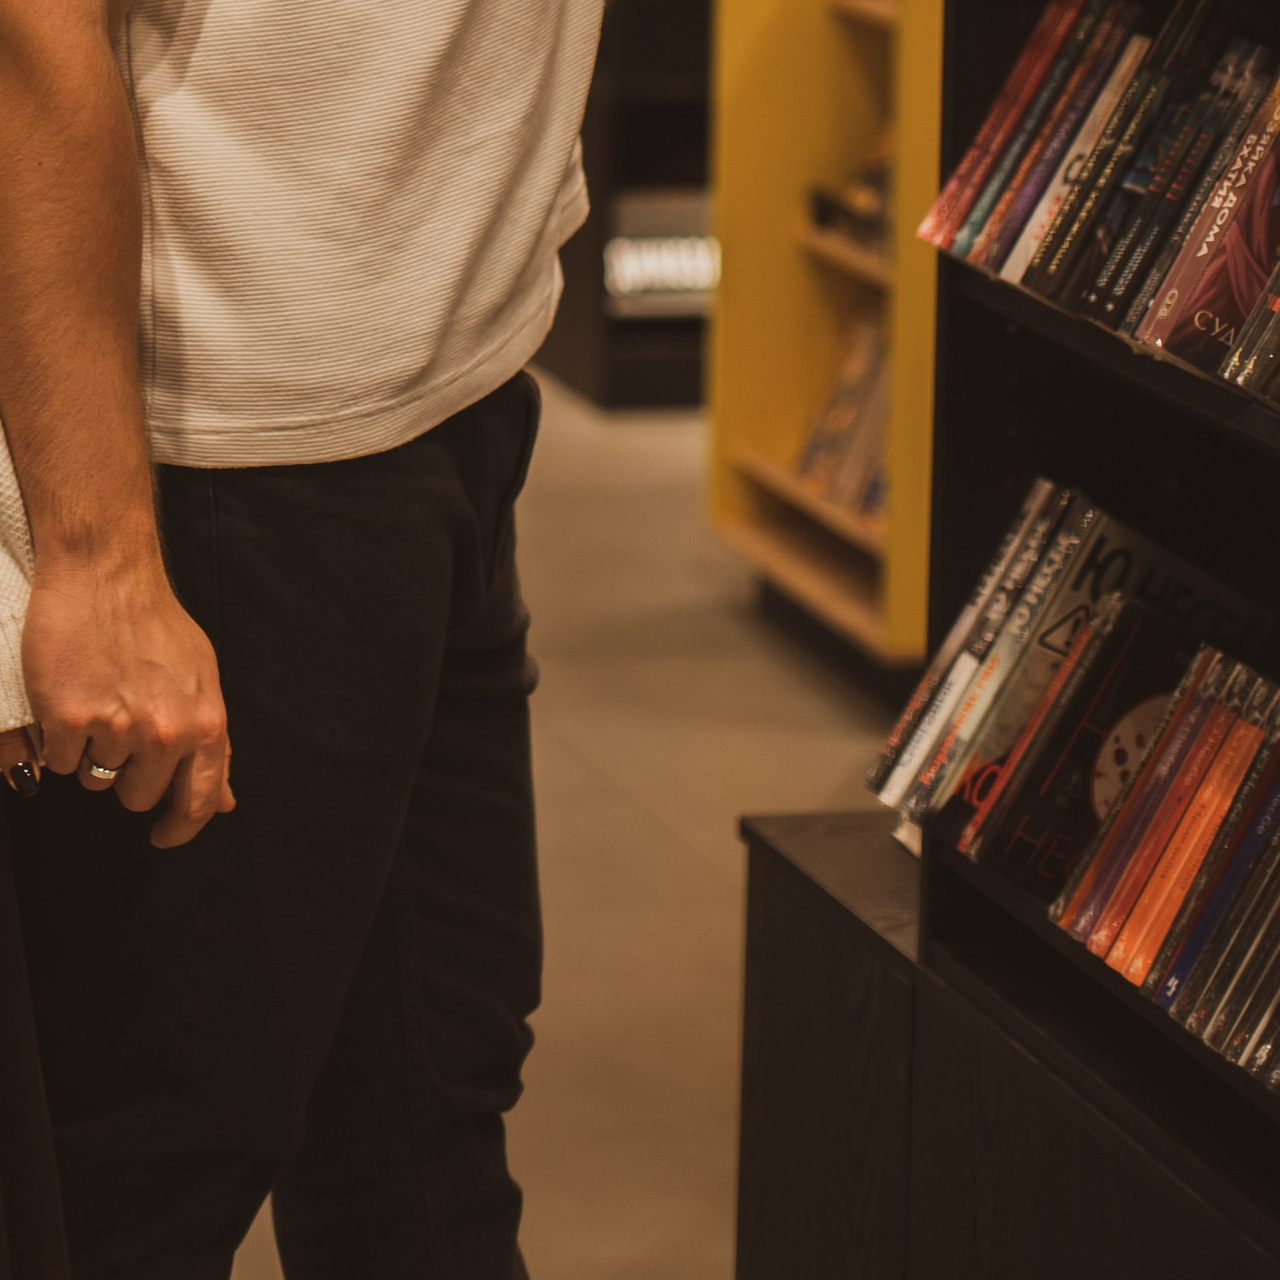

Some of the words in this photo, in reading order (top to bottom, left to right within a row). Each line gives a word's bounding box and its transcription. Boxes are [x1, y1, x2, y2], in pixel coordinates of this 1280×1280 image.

[1210, 133, 1258, 209] БХАТИЯ
[1234, 108, 1280, 189] ОЗЯЙКА
[1195, 191, 1238, 258] ДОМА
